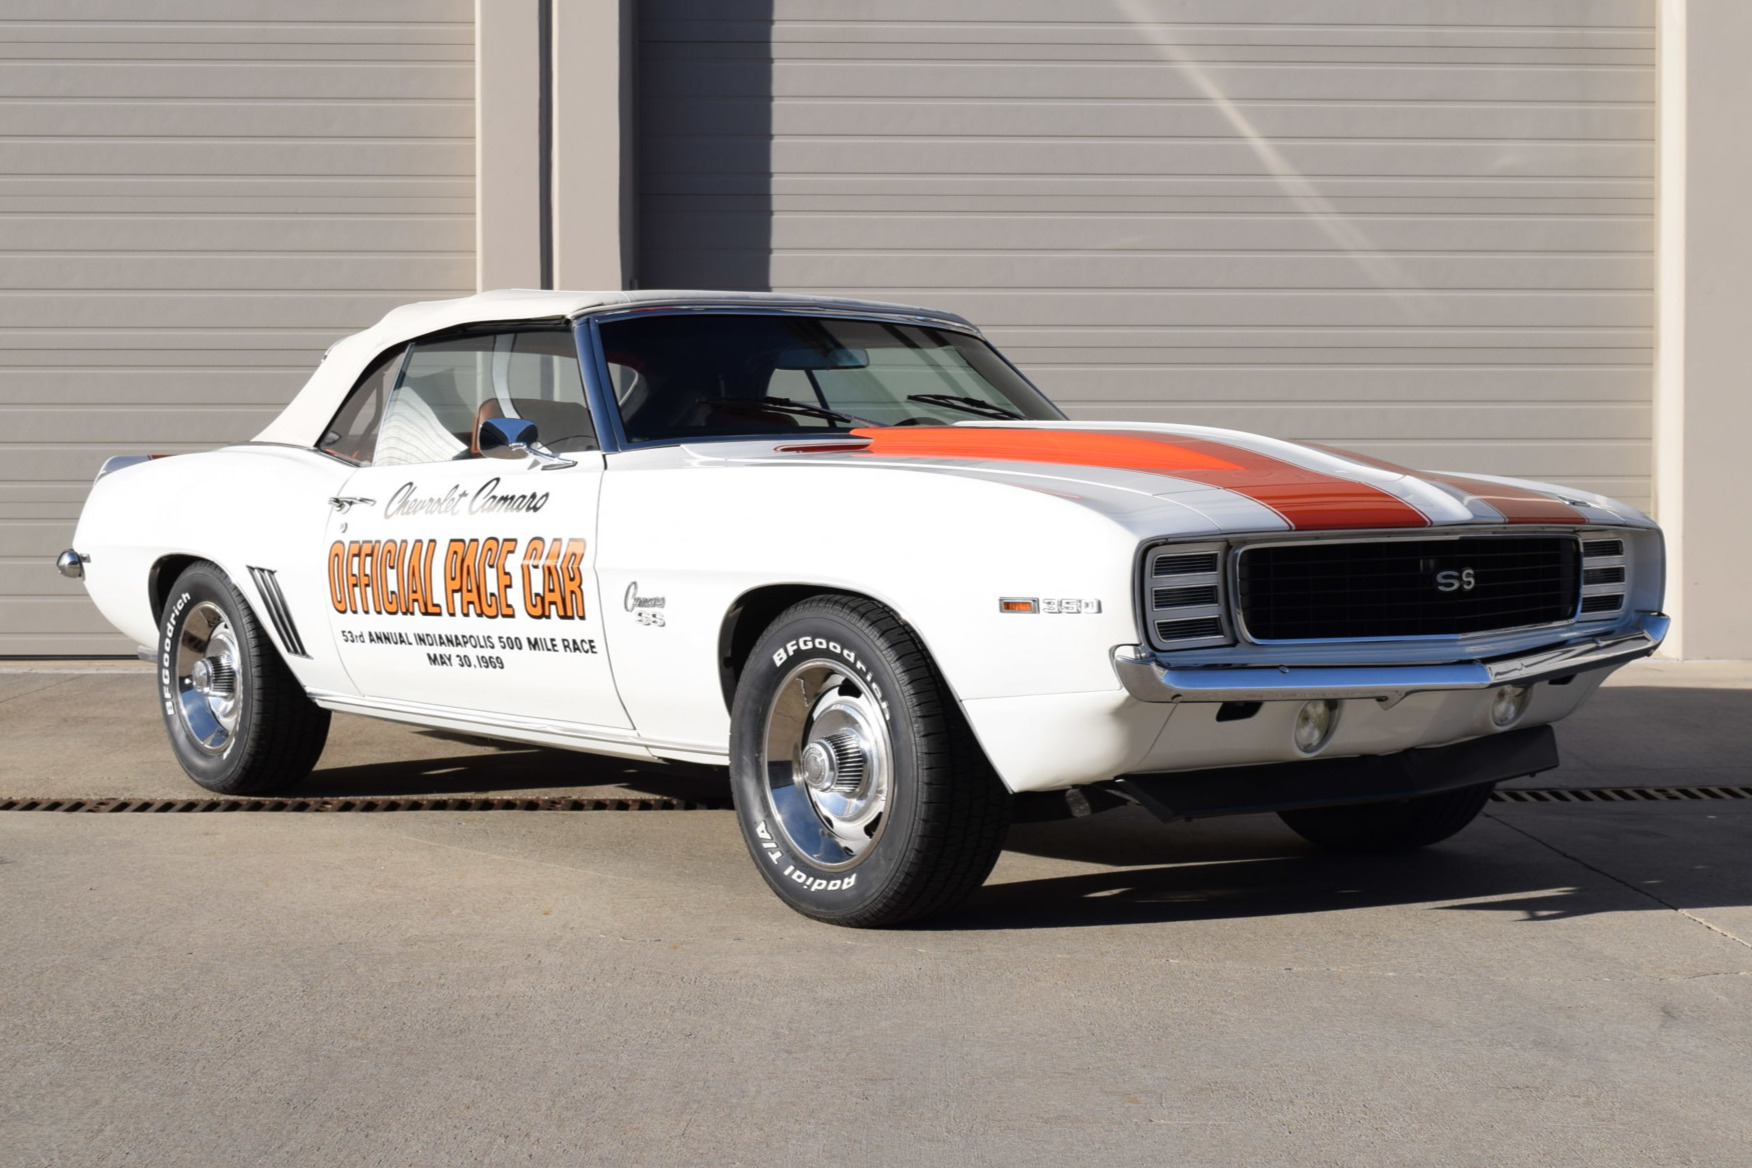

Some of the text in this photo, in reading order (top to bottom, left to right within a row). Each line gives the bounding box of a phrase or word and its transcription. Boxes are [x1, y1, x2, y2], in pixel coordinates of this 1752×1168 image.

[384, 476, 550, 520] Chevrolet Camaro
[328, 536, 587, 621] OFFICIAL PACE CAR
[1436, 567, 1475, 592] SS
[636, 610, 667, 628] SS
[161, 591, 191, 716] BFGoodrich
[341, 630, 598, 655] 53rd ANNUAL INDIANAPOLIS 500 MILE RACE
[426, 652, 453, 667] MAY
[772, 636, 891, 721] BFGoodrich
